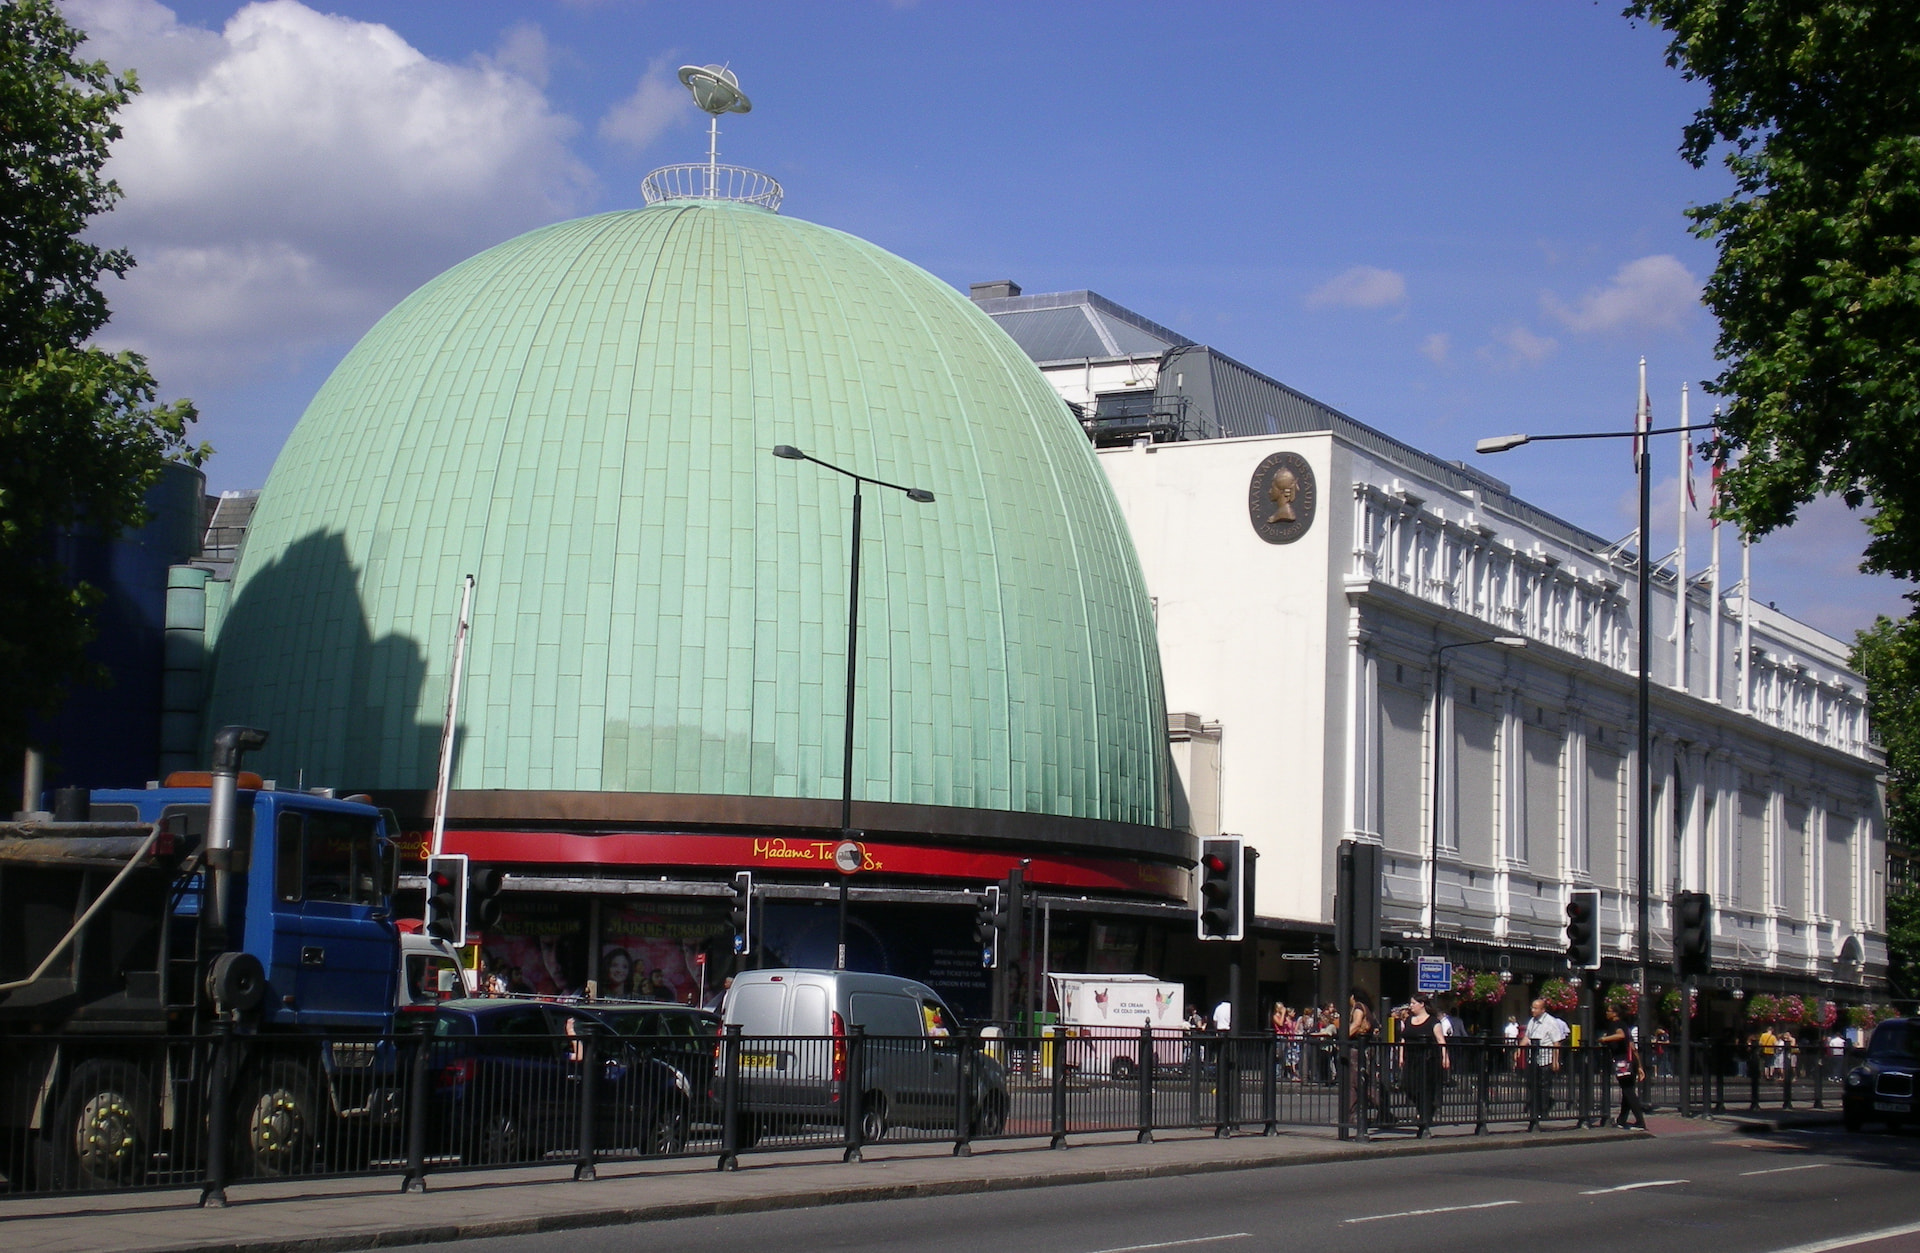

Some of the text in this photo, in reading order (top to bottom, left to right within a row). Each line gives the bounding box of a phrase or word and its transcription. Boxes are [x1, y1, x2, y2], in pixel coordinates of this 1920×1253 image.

[1251, 454, 1313, 512] MADAME TUSSAUD
[753, 838, 815, 860] Madame
